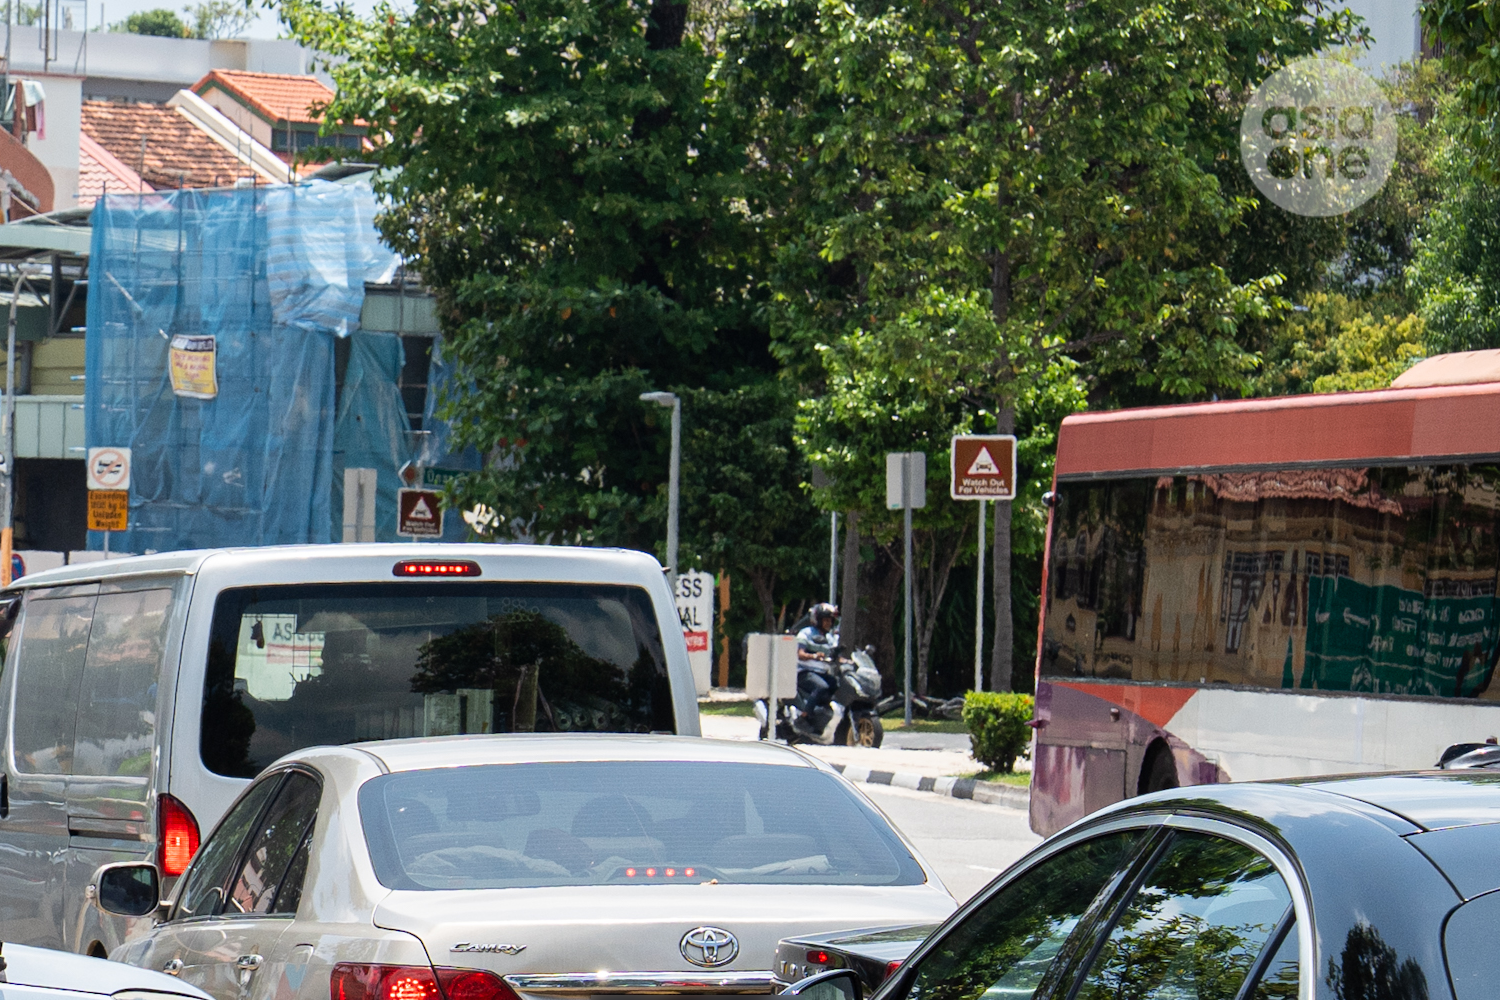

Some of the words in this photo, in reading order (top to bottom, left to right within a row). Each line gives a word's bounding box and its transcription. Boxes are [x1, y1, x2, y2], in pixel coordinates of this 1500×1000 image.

[962, 478, 988, 486] Watch
[989, 478, 1005, 486] Out
[974, 486, 1009, 494] Vehicles
